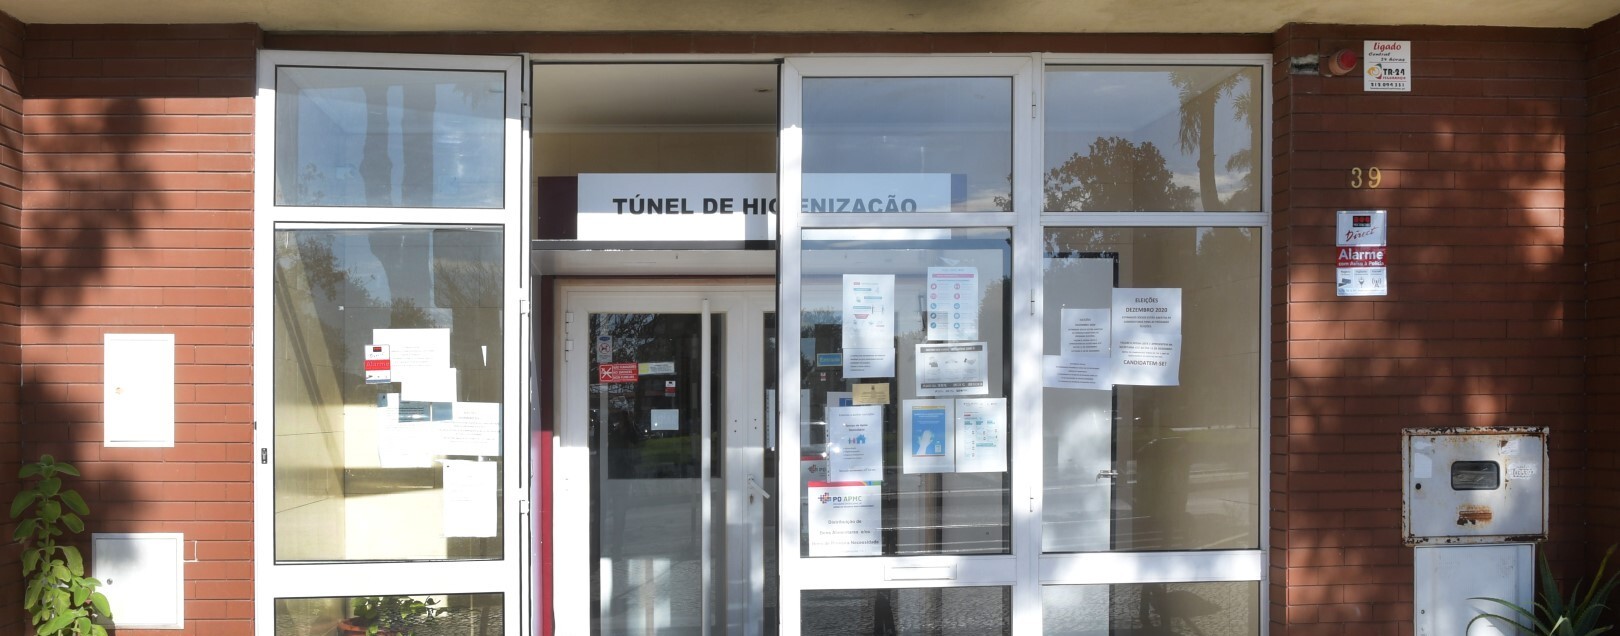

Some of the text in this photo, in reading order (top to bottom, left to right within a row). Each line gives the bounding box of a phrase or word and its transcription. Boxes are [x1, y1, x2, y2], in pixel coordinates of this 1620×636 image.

[1373, 42, 1402, 52] Ligado
[1383, 68, 1405, 76] TR-24
[1351, 166, 1381, 188] 39
[613, 194, 694, 215] TÚNEL
[702, 198, 734, 215] DE
[1338, 248, 1384, 260] Alarme
